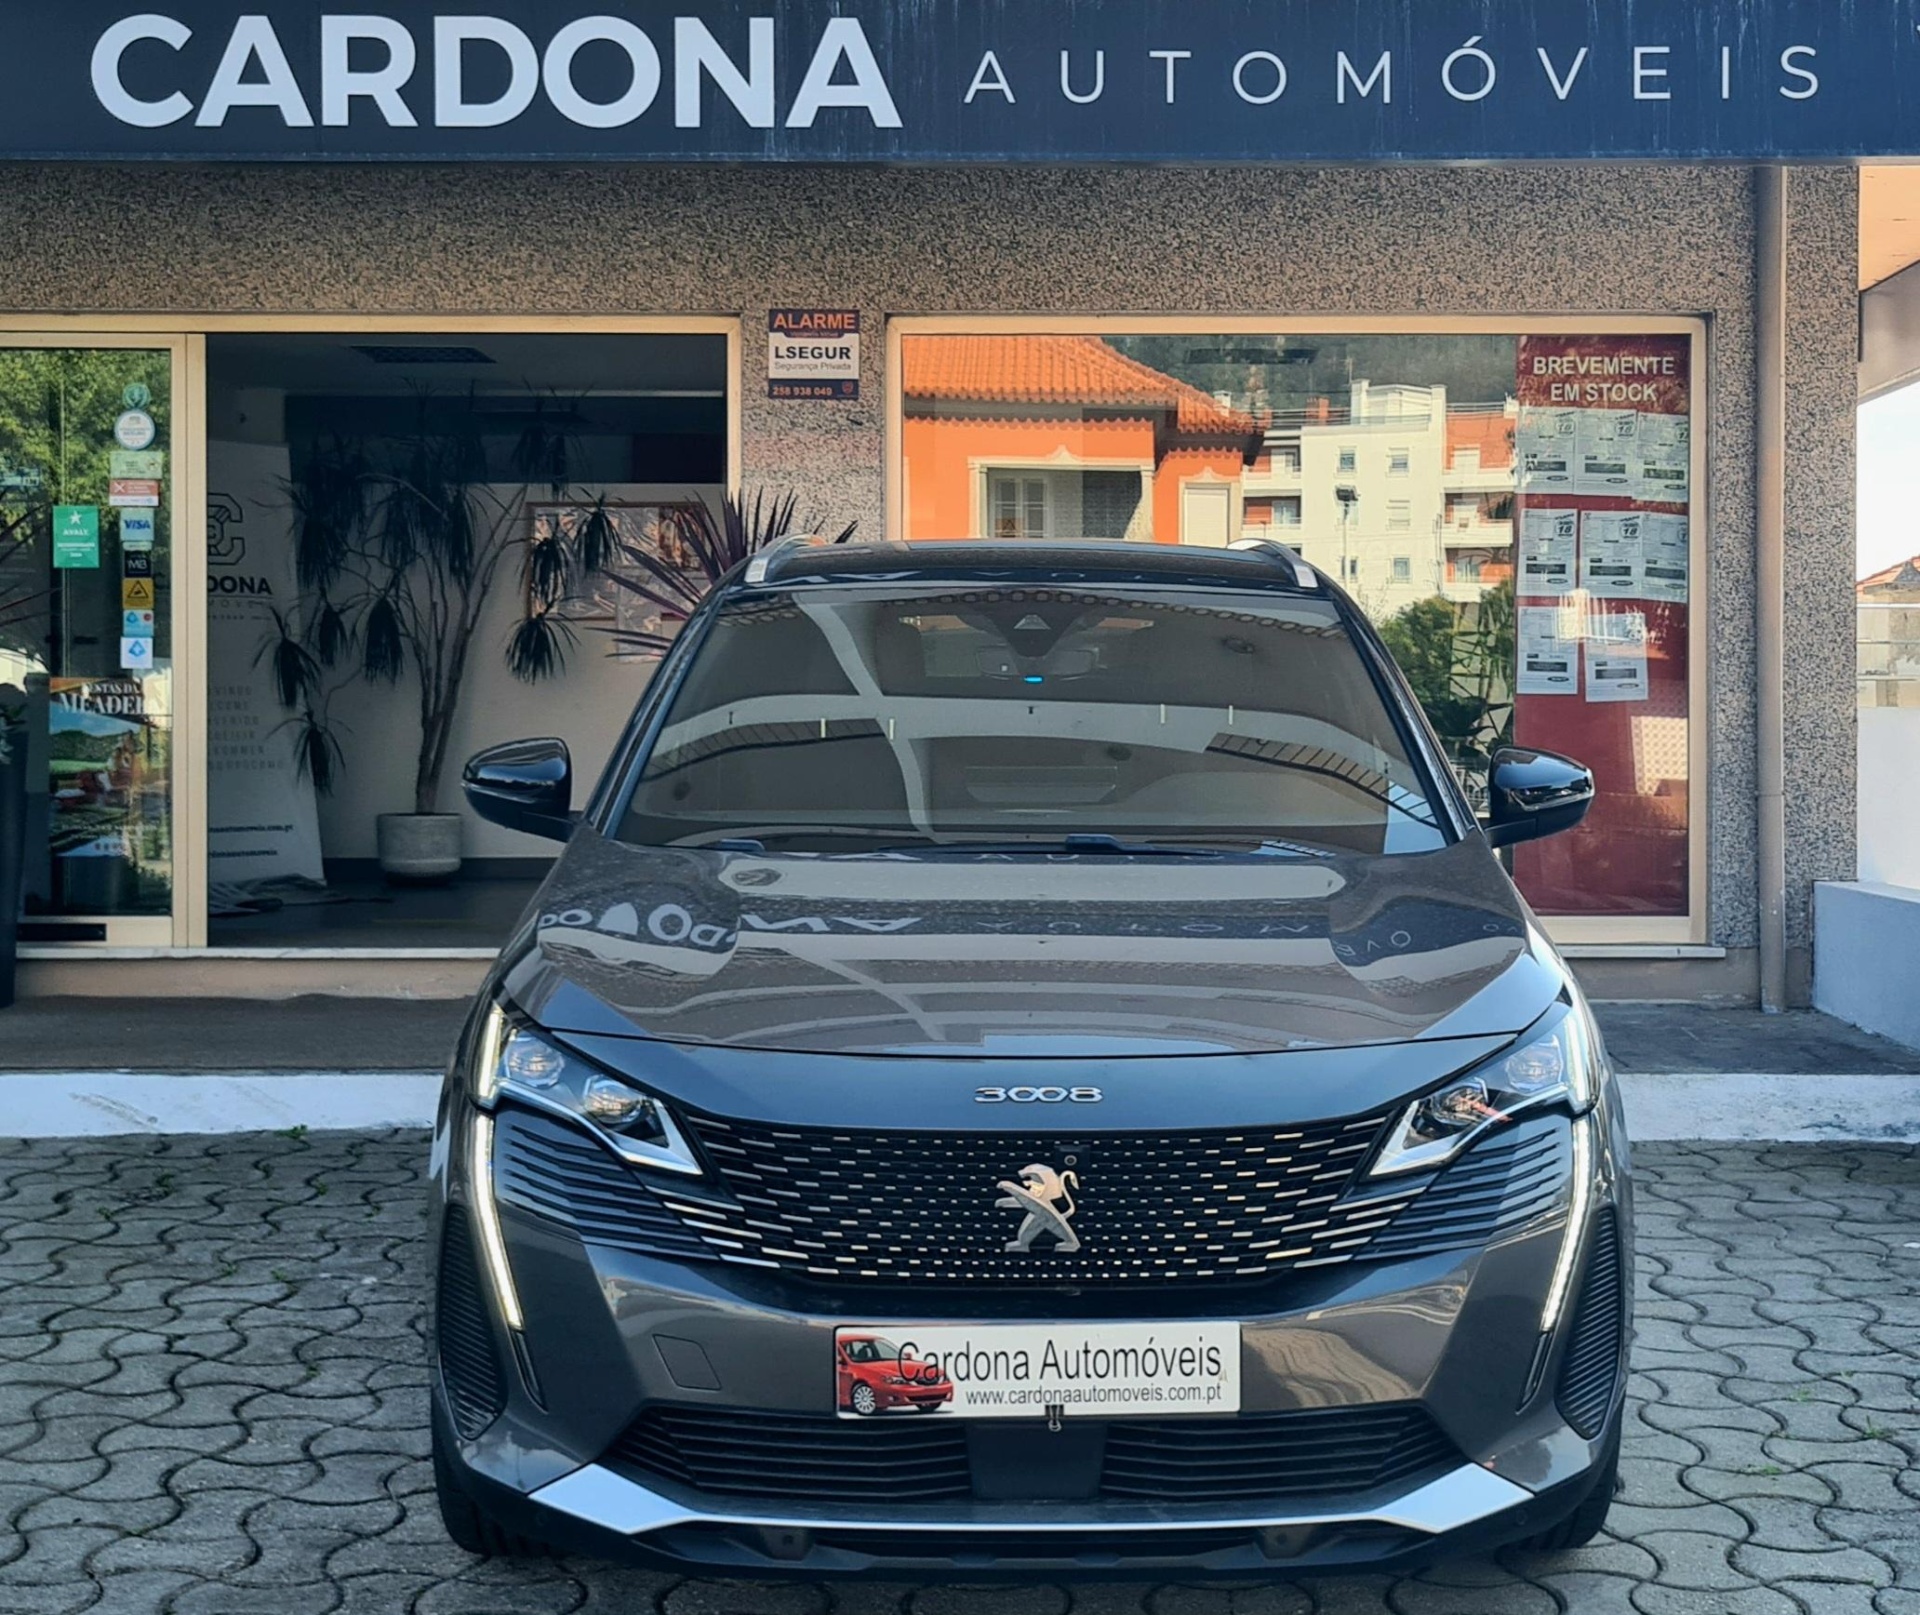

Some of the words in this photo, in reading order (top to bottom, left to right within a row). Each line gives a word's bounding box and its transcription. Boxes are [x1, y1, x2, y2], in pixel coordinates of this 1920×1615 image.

[90, 13, 904, 128] CARDONA
[963, 35, 1819, 104] AUTOMÓVEIS
[773, 312, 856, 329] ALARME
[774, 346, 851, 360] LSEGUR
[774, 361, 819, 372] Segurança
[820, 361, 851, 371] Privada
[1533, 356, 1675, 375] BREVEMENTE
[1550, 383, 1580, 401] EM
[1586, 382, 1657, 401] STOCK
[124, 519, 150, 530] VISA
[1558, 524, 1572, 534] 18
[1623, 527, 1637, 536] 18
[974, 1086, 1103, 1102] 3008
[898, 1340, 1030, 1382] Cardona
[1039, 1335, 1222, 1380] Automóveis
[965, 1382, 1222, 1405] www.cardonaautomoveis.com.pt
